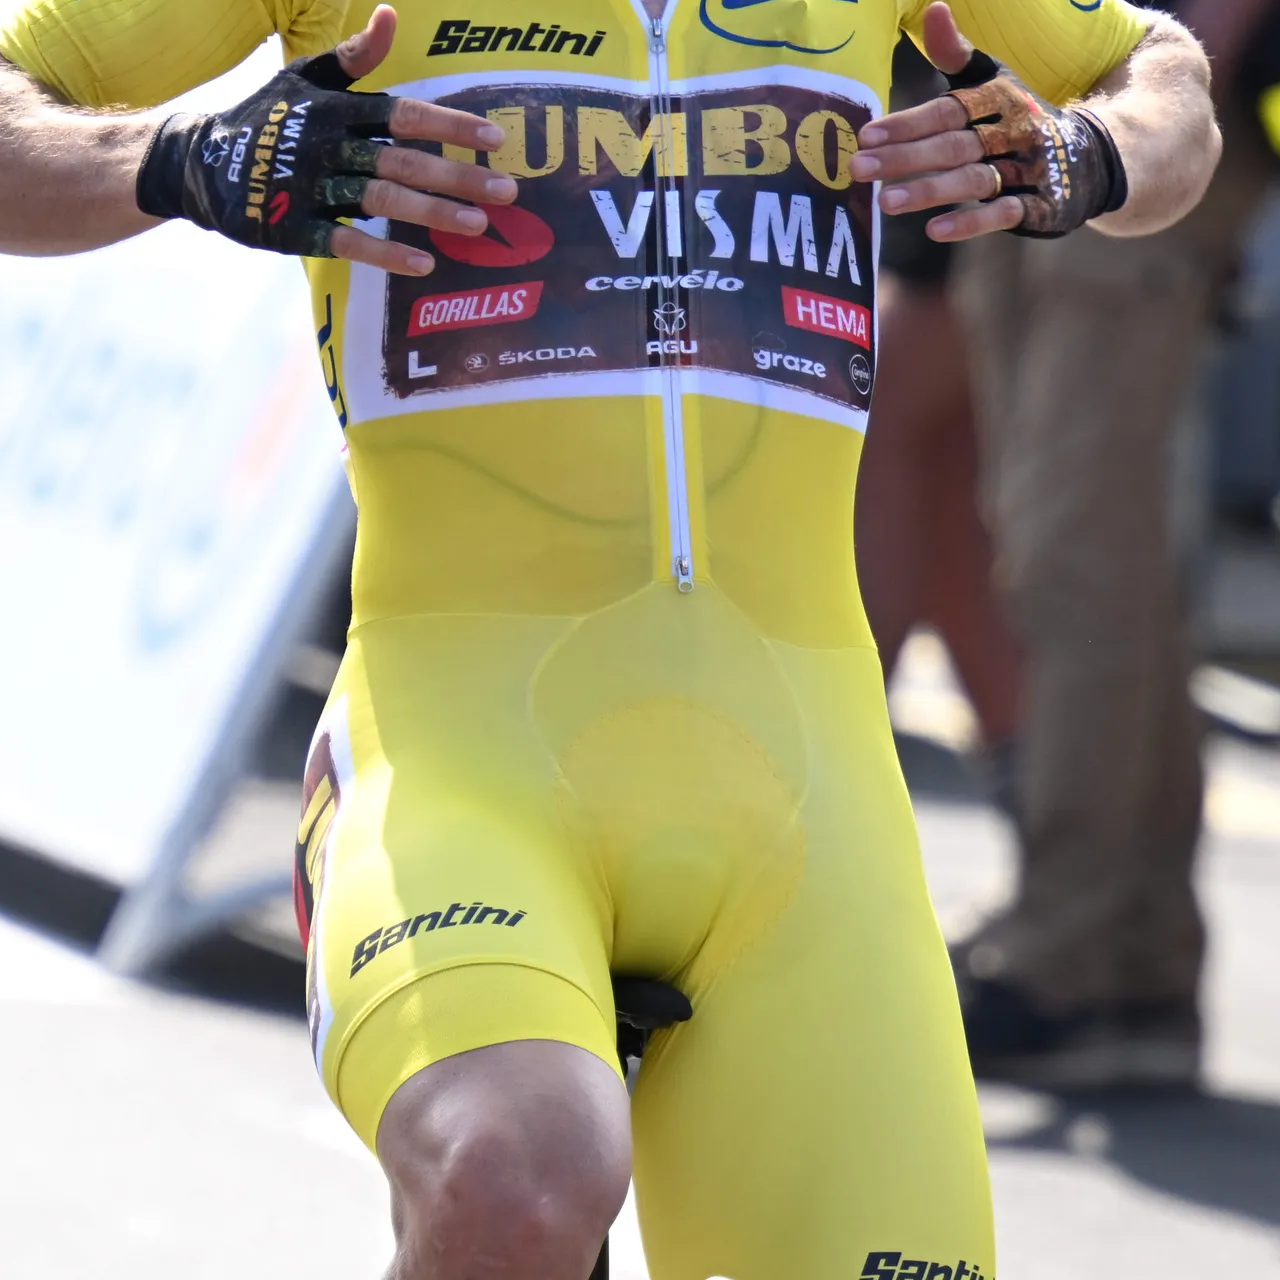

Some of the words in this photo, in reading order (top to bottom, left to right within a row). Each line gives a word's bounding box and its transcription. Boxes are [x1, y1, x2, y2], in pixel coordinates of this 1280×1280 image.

[426, 20, 607, 57] Santini
[228, 127, 253, 183] AGU
[245, 100, 290, 222] JUMBO
[273, 100, 313, 180] VISMA
[442, 104, 861, 190] UMBO
[589, 189, 862, 286] VISMA
[585, 269, 745, 292] cervélo
[418, 289, 528, 328] GORILLAS
[796, 295, 867, 341] HEMA
[646, 340, 698, 355] AGU
[753, 348, 827, 378] graze
[349, 902, 528, 980] Santini
